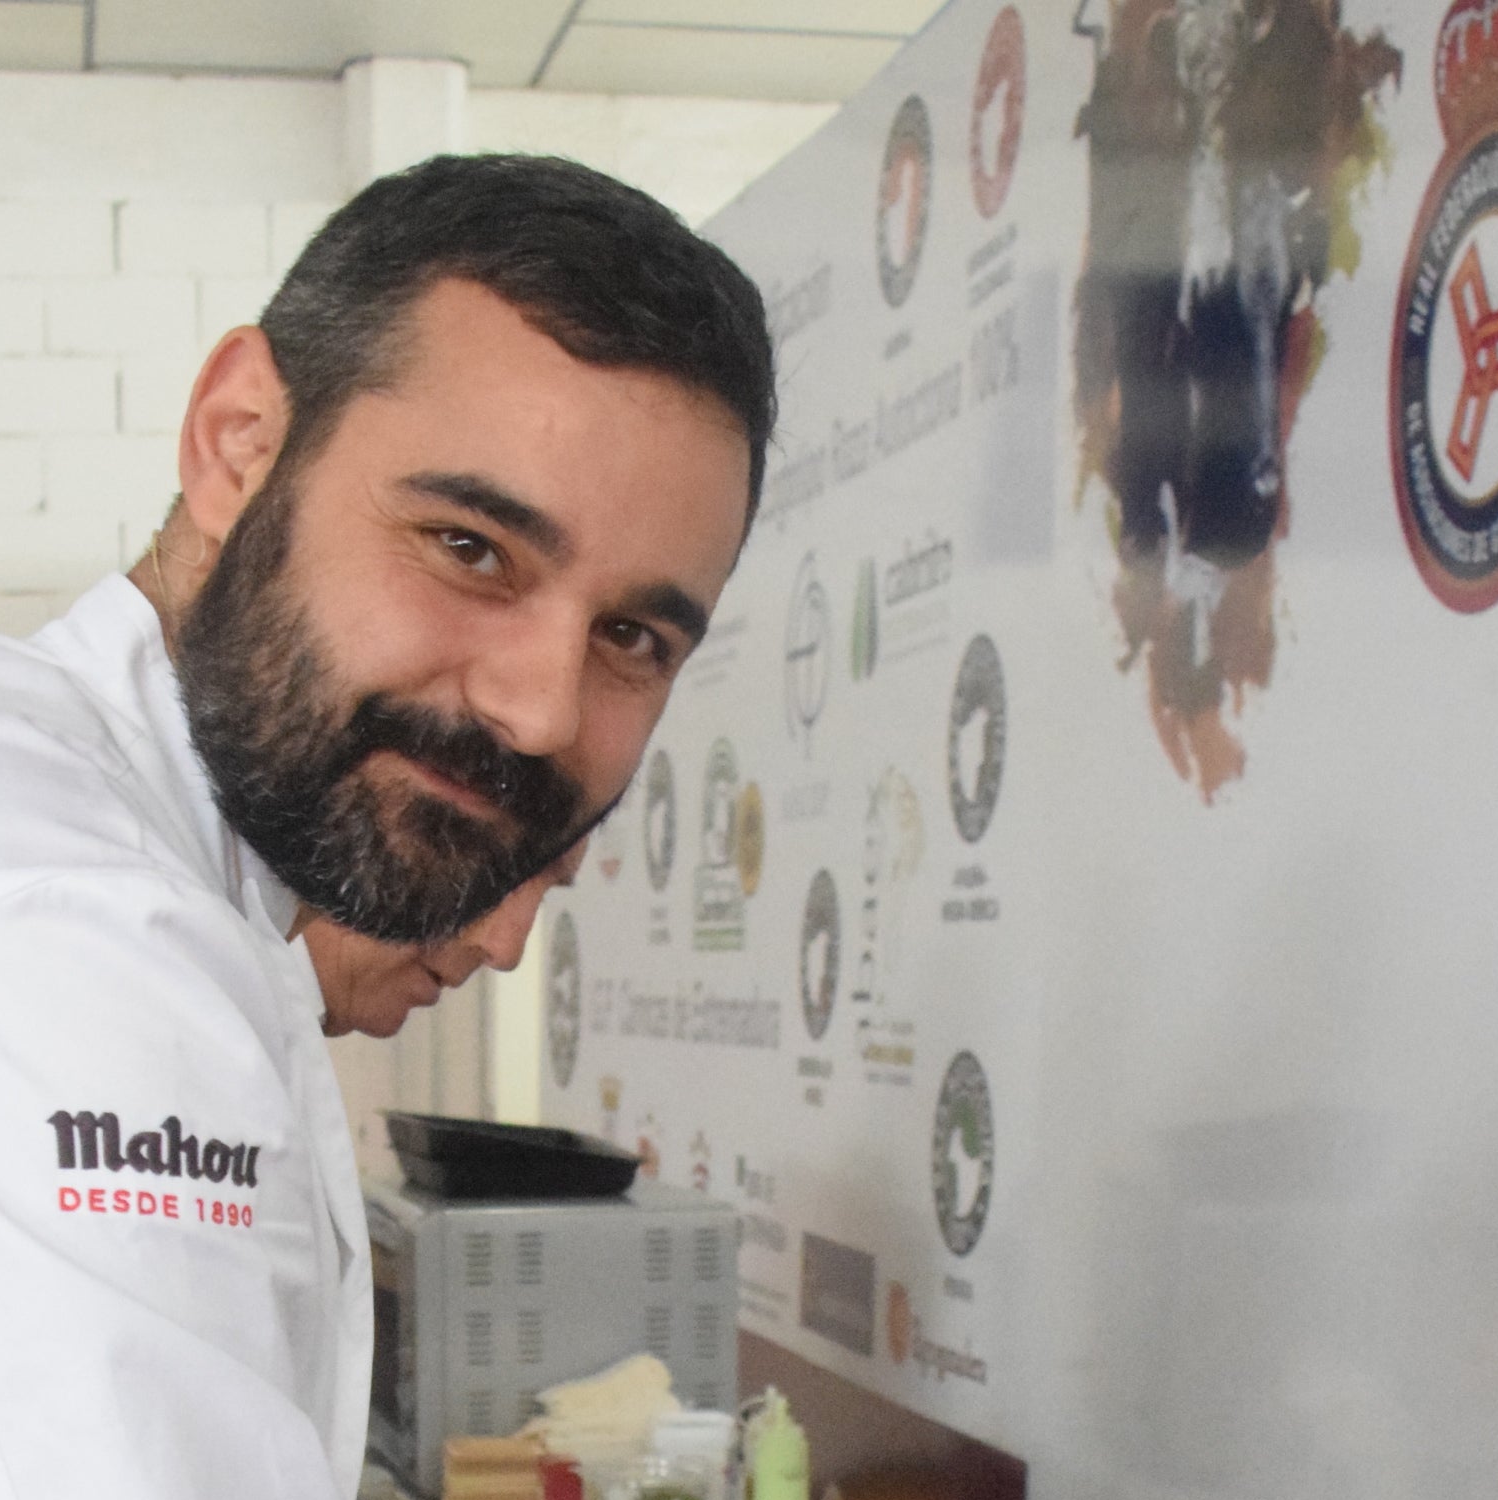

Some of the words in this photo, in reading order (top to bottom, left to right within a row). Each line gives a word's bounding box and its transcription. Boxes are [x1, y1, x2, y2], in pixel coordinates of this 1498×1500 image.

[47, 1109, 262, 1189] Mahou
[58, 1186, 180, 1219] DESDE
[196, 1197, 253, 1228] 1890
